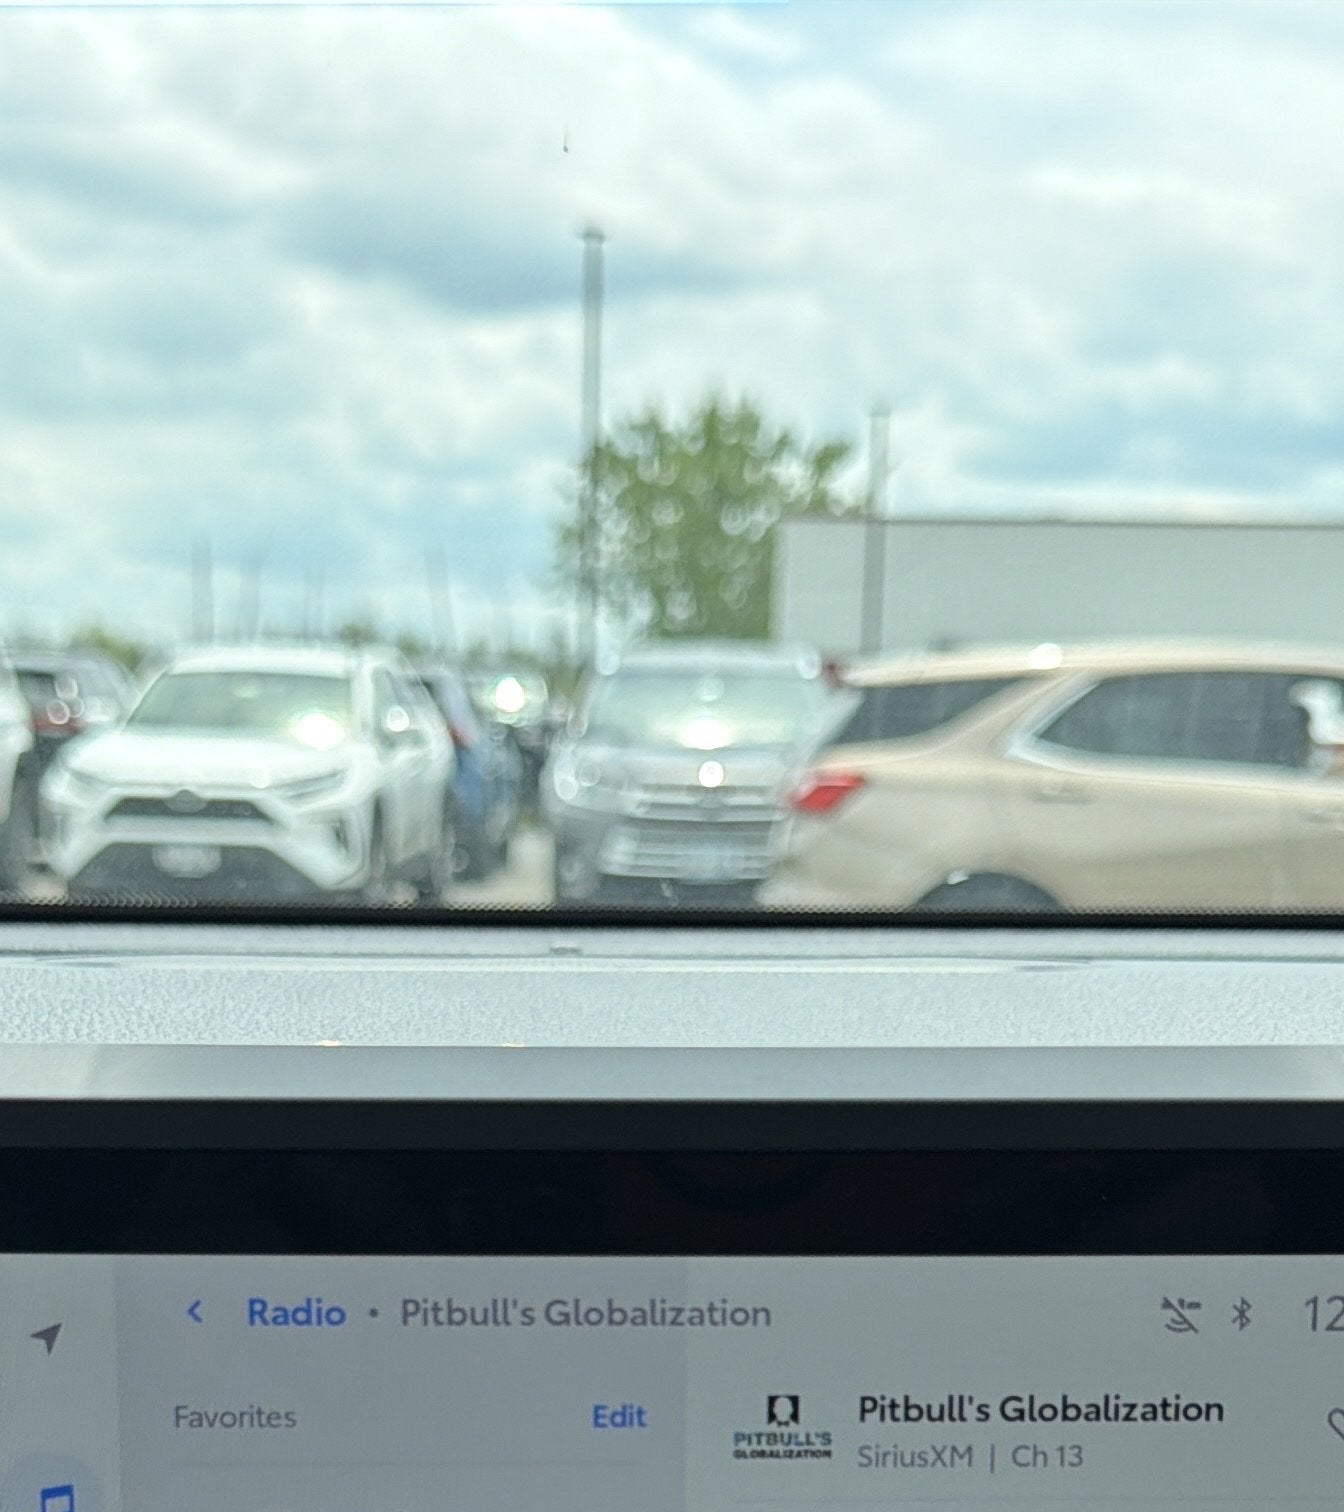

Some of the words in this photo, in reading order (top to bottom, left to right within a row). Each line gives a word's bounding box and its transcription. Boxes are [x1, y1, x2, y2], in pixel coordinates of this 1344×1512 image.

[248, 1297, 347, 1327] Radio
[401, 1297, 536, 1327] Pitbull's
[543, 1297, 772, 1327] Globalization
[173, 1404, 297, 1429] Favorites
[592, 1403, 647, 1429] Edit
[859, 1394, 991, 1423] Pitbull's
[999, 1393, 1224, 1423] Globalization
[857, 1443, 974, 1469] SiriusXM
[1011, 1443, 1049, 1468] Ch
[1056, 1444, 1084, 1468] 13
